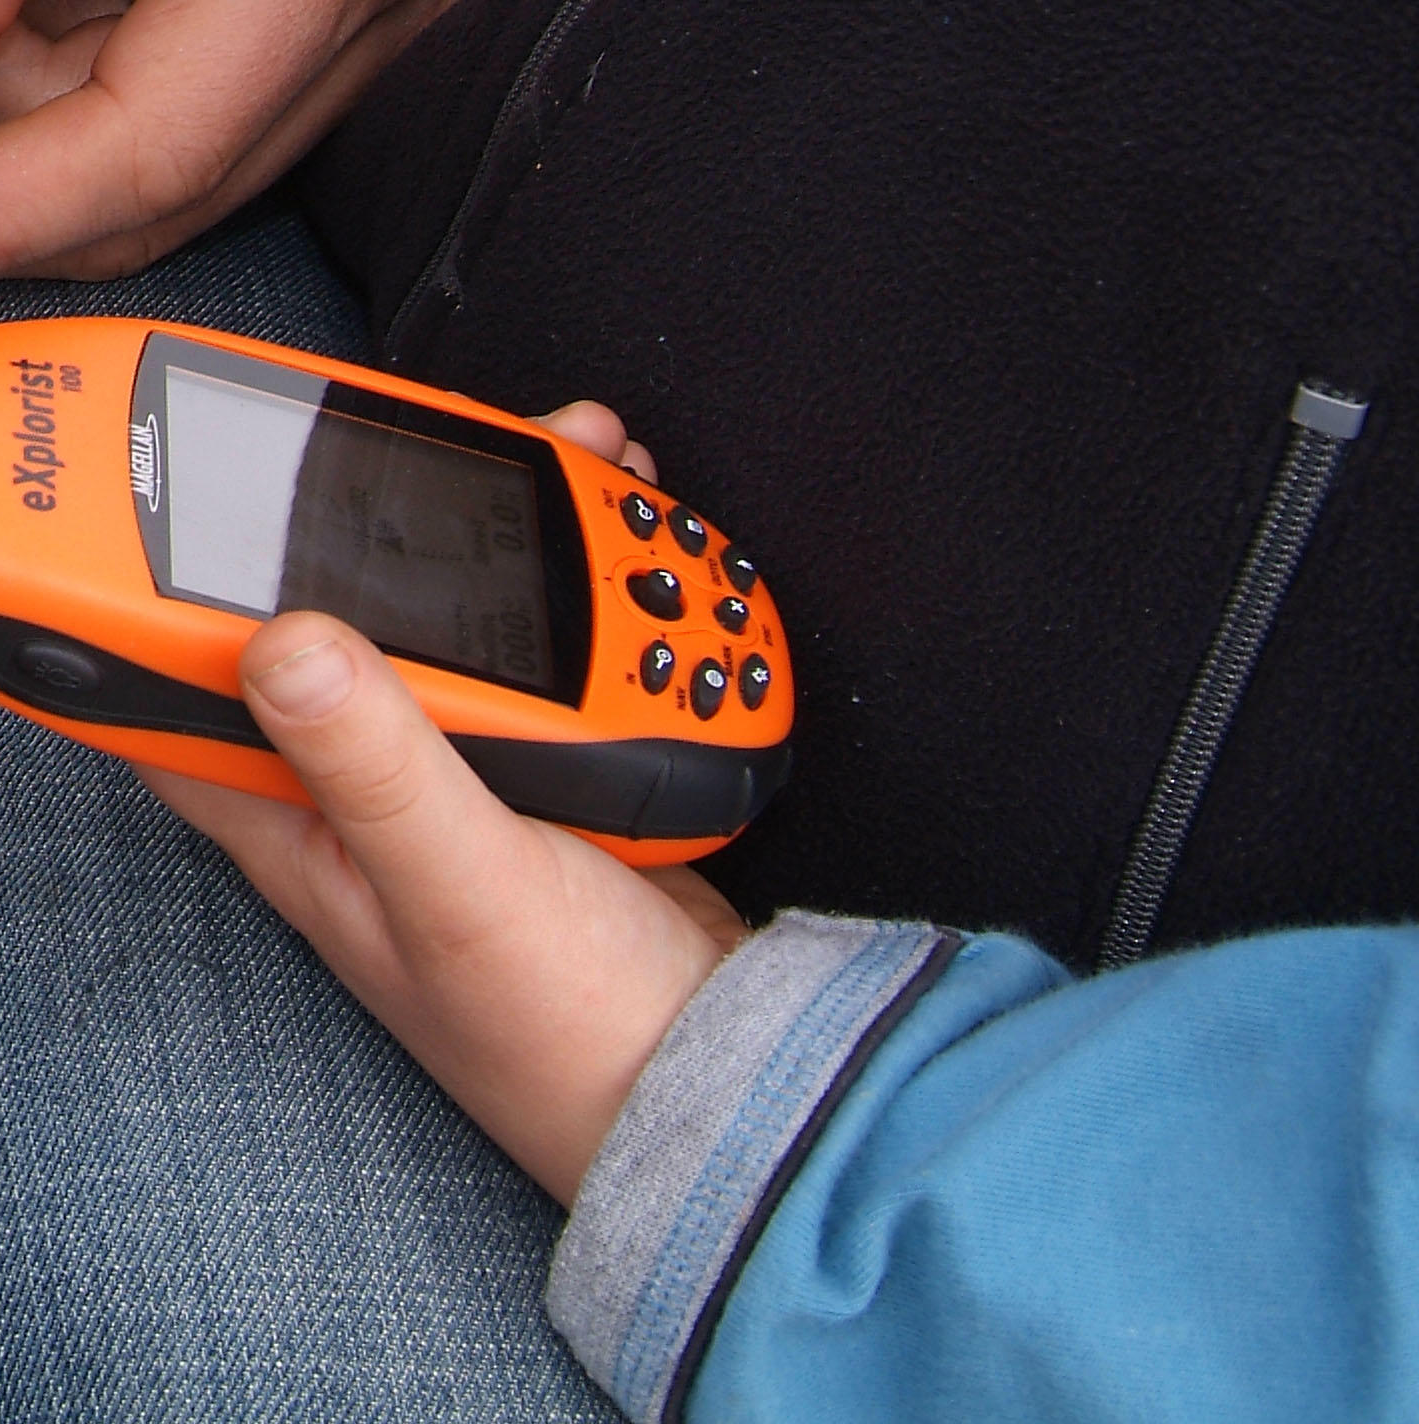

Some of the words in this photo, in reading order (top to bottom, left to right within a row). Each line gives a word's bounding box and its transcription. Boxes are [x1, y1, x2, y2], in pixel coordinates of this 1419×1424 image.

[59, 364, 82, 393] 100
[10, 359, 65, 512] eXplorist
[130, 424, 154, 496] MAGELLAN
[675, 686, 687, 712] NAV
